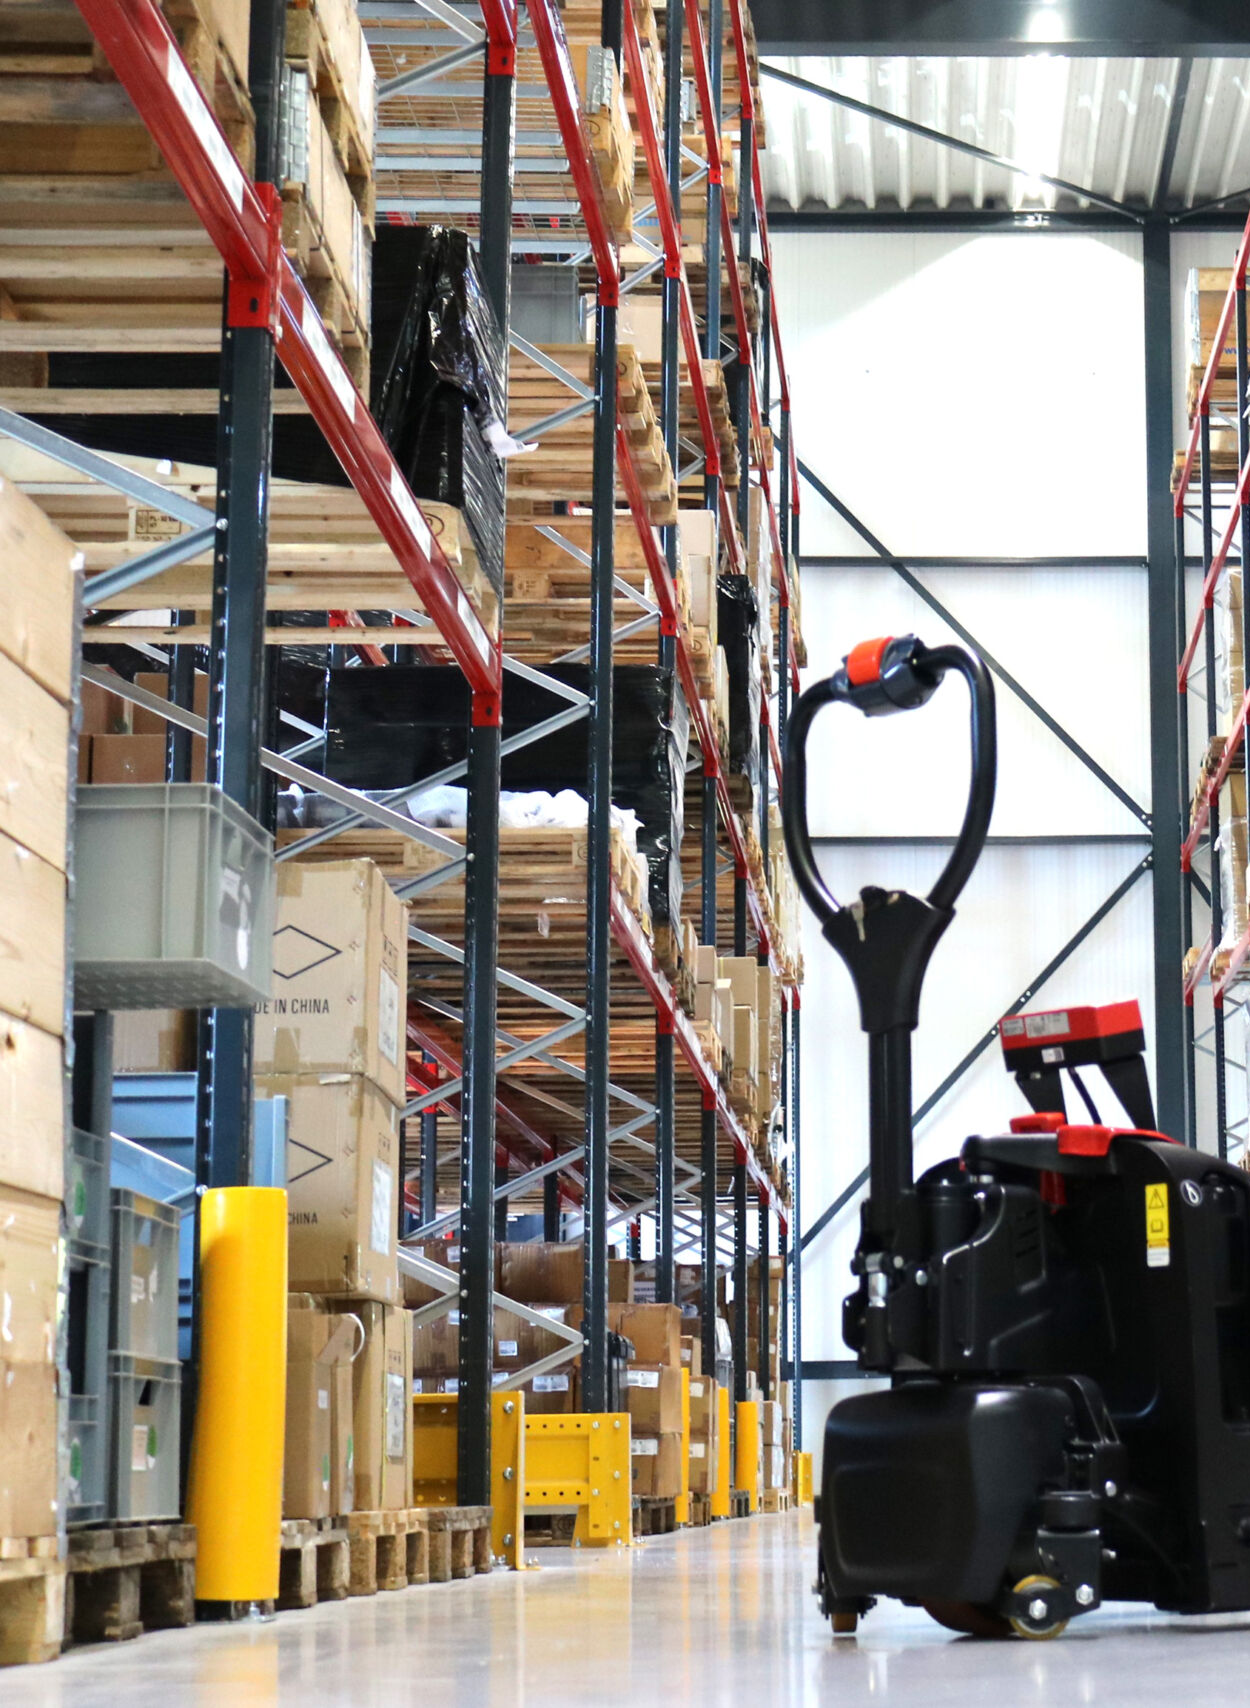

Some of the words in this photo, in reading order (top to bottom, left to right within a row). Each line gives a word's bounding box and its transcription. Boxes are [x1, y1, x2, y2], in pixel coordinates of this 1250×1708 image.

[254, 1001, 269, 1014] DE
[274, 999, 287, 1014] IN
[291, 998, 330, 1014] CHINA
